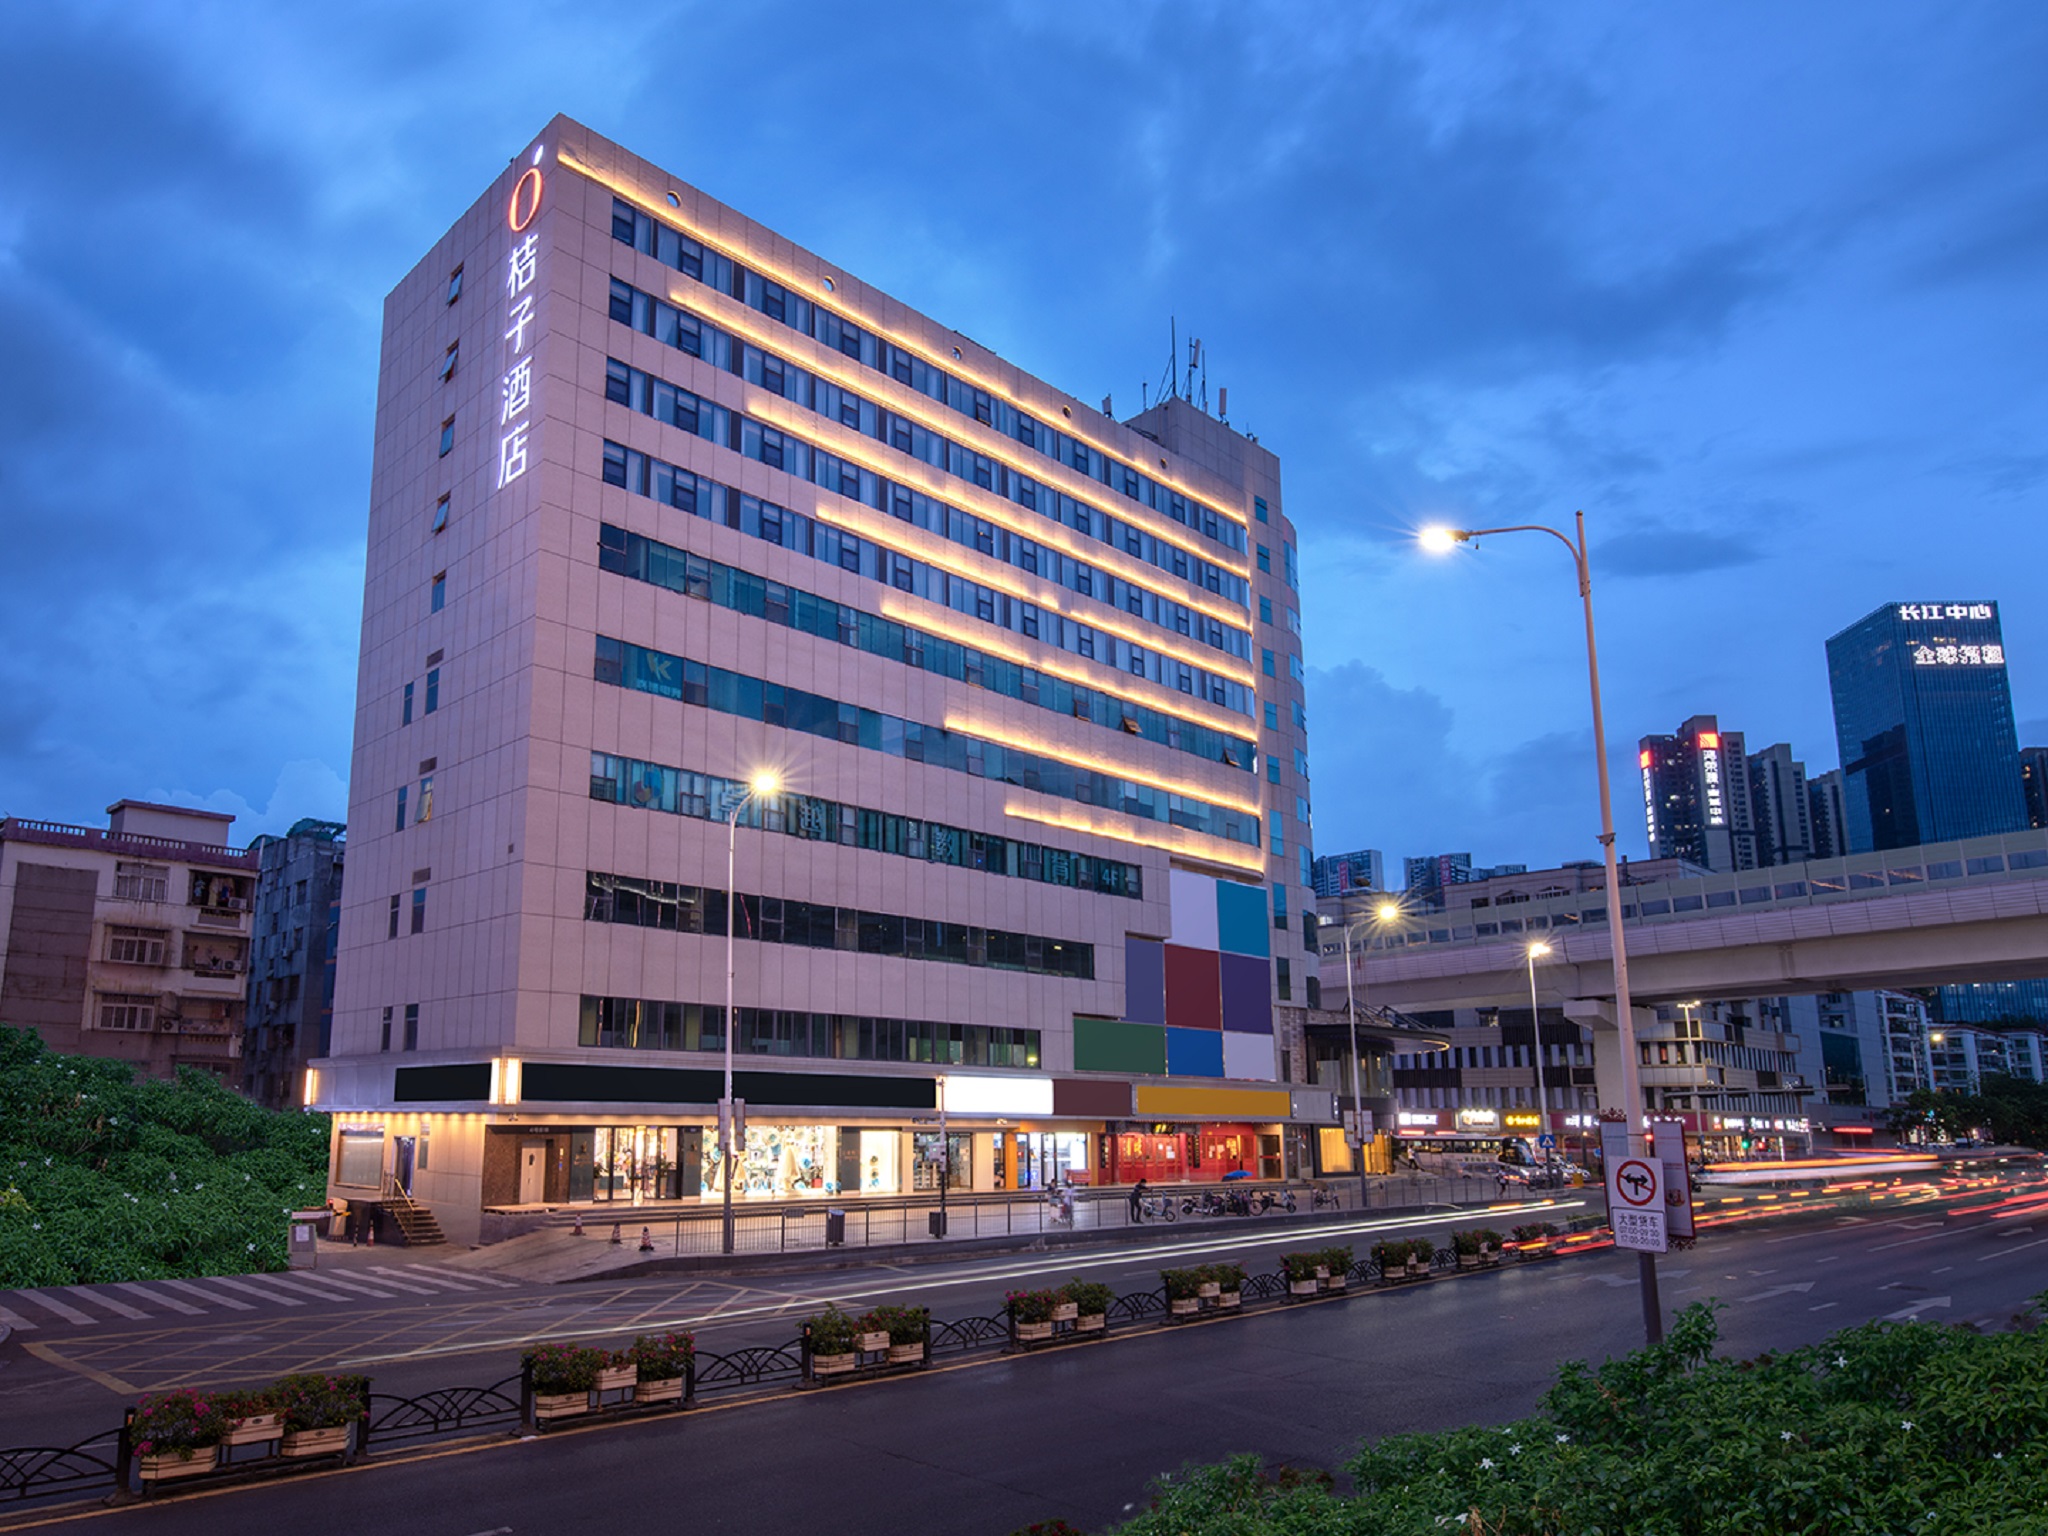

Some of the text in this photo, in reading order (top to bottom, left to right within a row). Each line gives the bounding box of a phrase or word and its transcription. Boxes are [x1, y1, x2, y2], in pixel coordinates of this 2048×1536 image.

[497, 233, 539, 490] 桔子酒店
[1899, 603, 1993, 621] 长江中心
[1618, 1213, 1659, 1228] 大型货车
